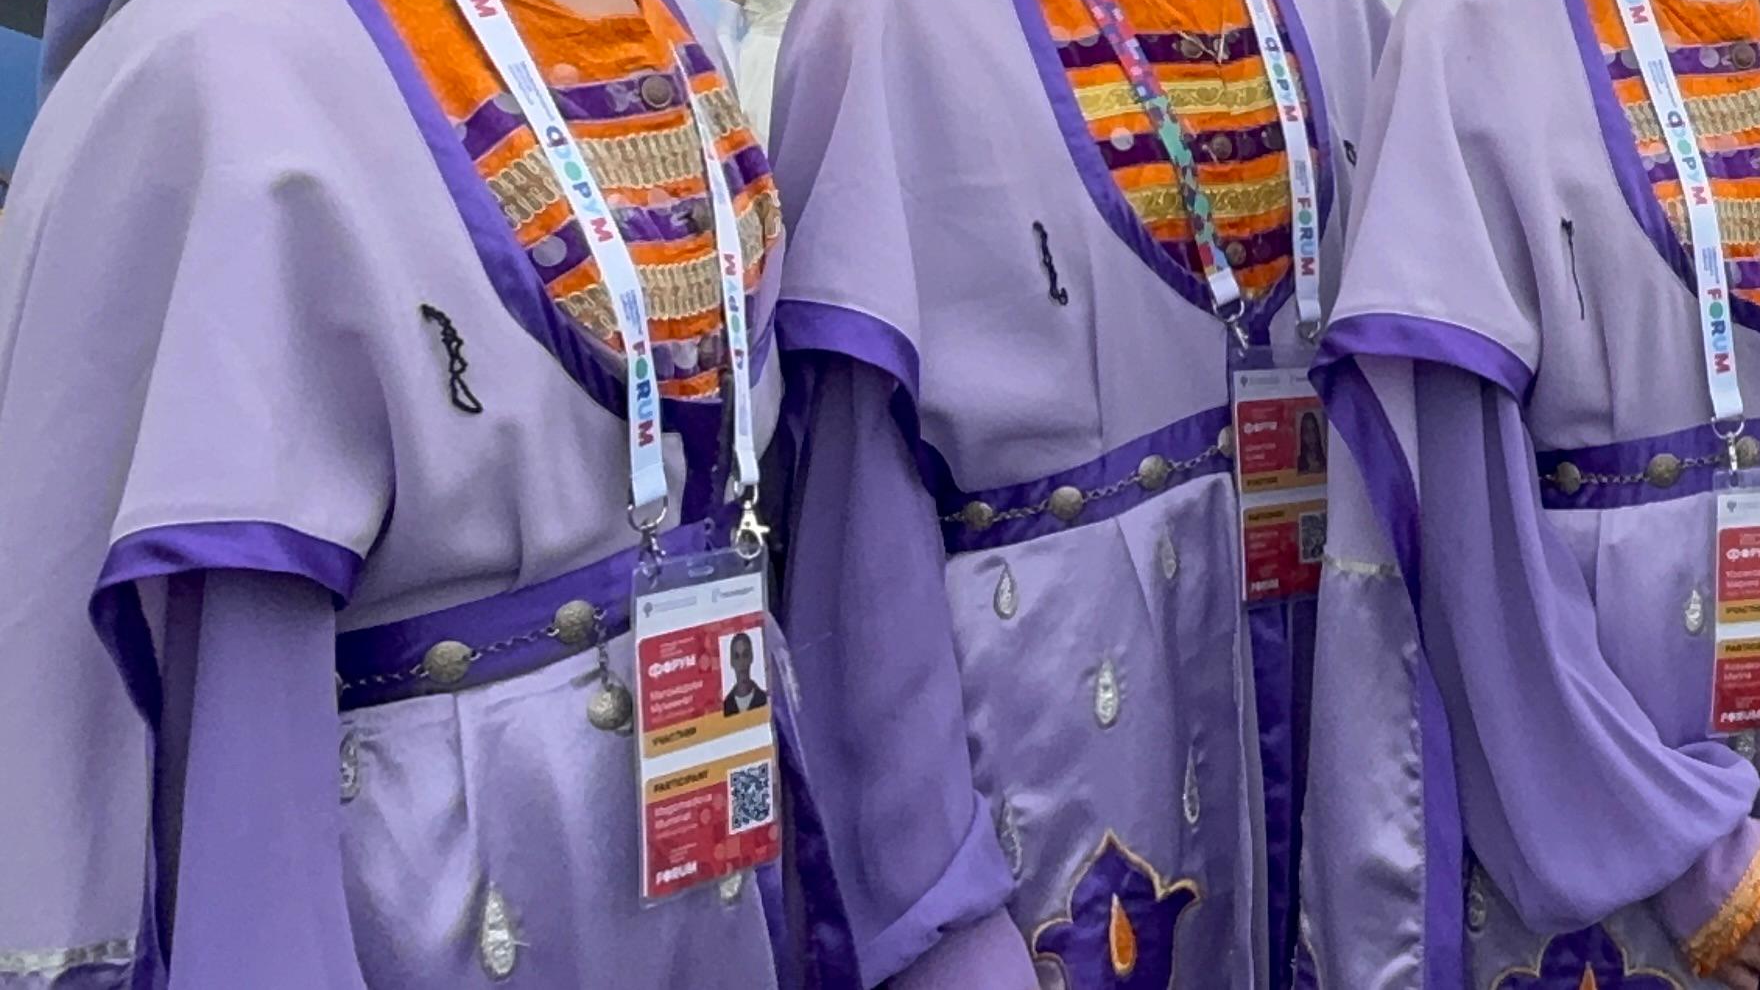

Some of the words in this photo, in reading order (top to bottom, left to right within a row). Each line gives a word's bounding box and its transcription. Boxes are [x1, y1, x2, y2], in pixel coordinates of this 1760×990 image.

[1264, 36, 1299, 123] ФОРУМ
[545, 125, 614, 243] ФОРУМ
[1666, 110, 1711, 207] ФОРУМ
[1296, 197, 1316, 276] FORUM
[1707, 287, 1731, 375] FORUM
[631, 340, 655, 447] FORUM
